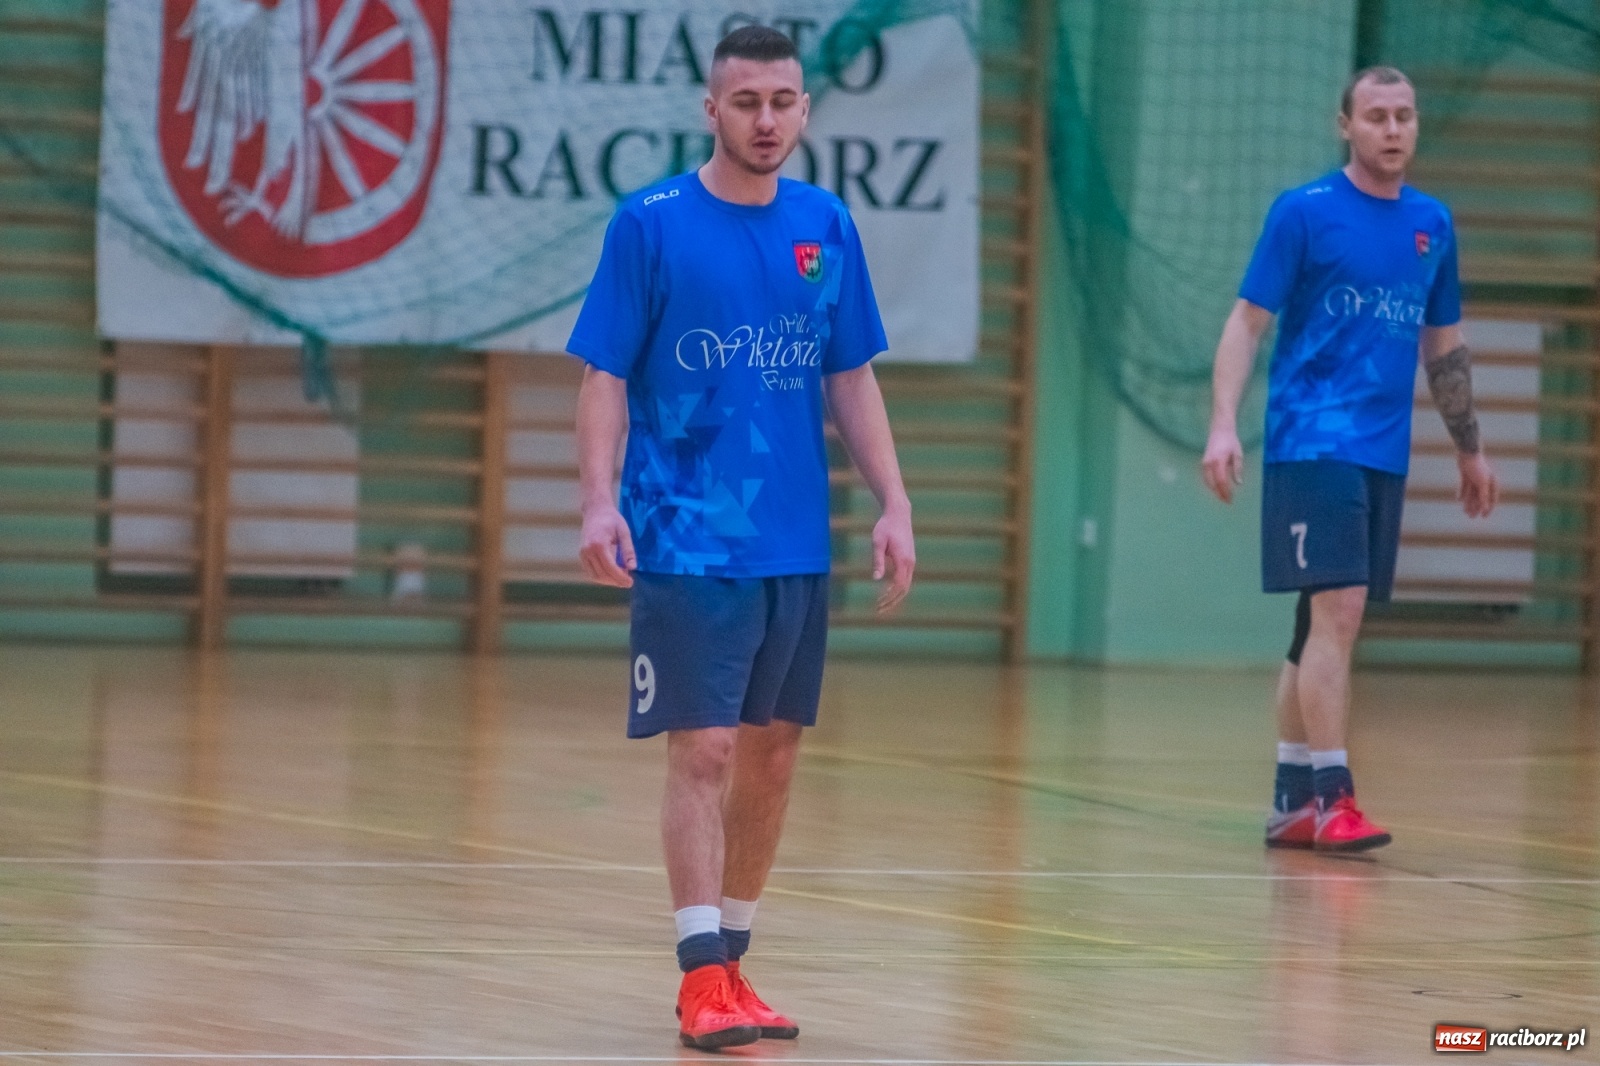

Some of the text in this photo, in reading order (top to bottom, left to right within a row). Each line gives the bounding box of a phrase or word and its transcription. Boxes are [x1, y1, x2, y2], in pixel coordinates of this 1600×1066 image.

[471, 121, 944, 211] RACIRZ
[643, 188, 680, 206] COLO
[1289, 522, 1308, 569] 7
[634, 653, 655, 714] 9
